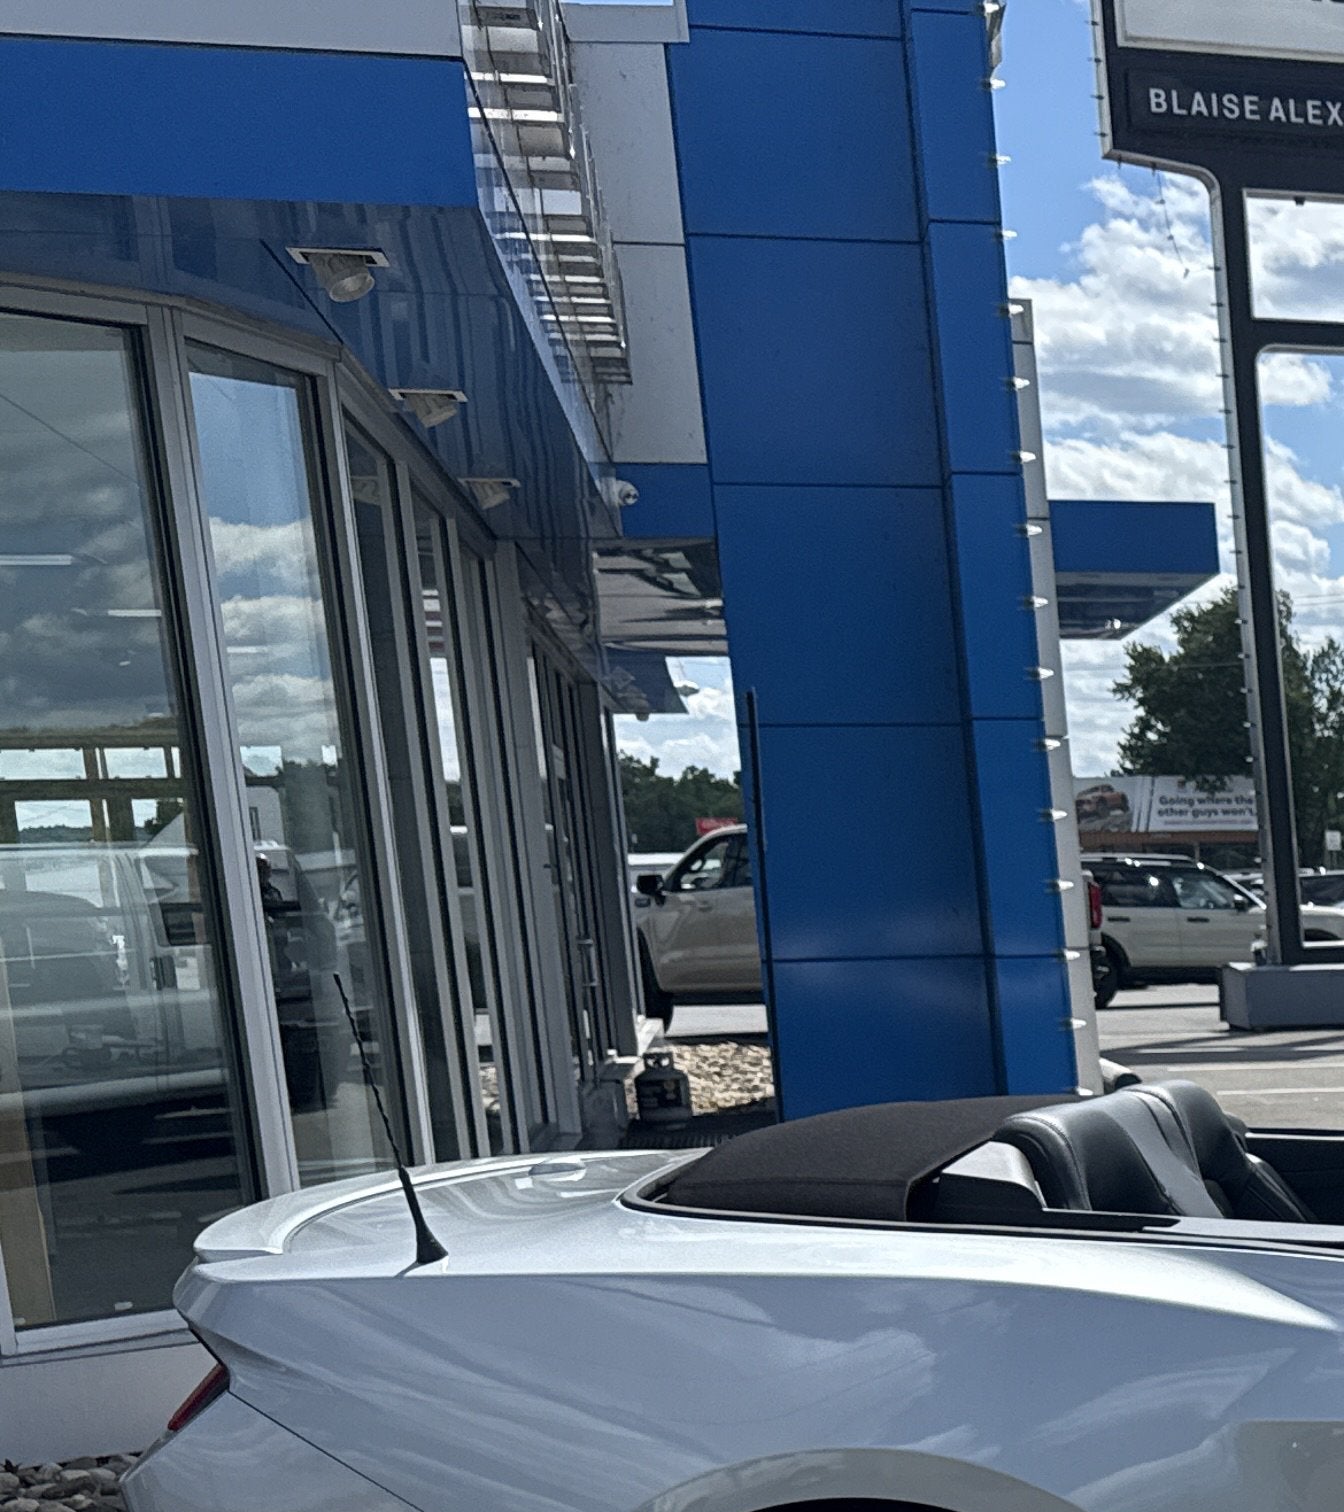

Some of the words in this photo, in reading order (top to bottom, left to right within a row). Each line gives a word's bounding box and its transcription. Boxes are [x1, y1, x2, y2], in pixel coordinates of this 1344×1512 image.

[1149, 87, 1261, 120] BLAISE
[1158, 795, 1195, 808] Going
[1157, 807, 1189, 817] other
[1191, 808, 1219, 819] guys
